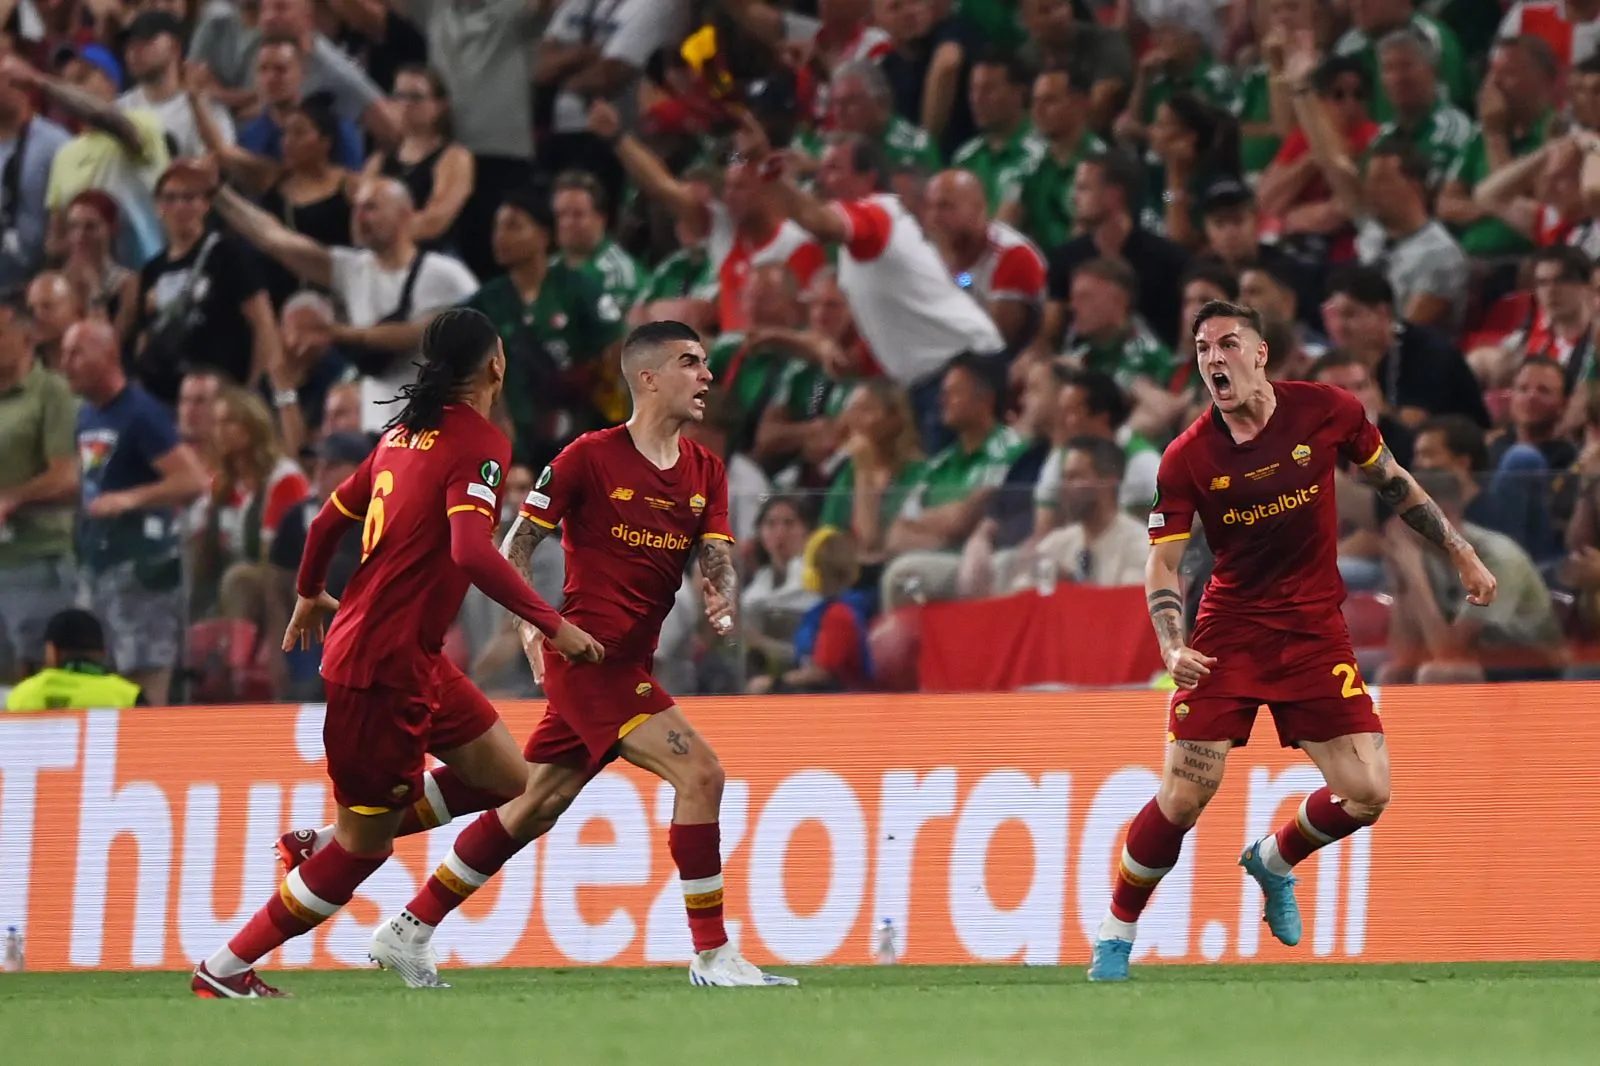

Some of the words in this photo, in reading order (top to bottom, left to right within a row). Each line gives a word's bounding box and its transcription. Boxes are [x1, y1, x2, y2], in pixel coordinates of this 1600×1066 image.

[361, 470, 394, 564] 6
[611, 523, 692, 550] digitalbit
[1331, 662, 1370, 699] 2
